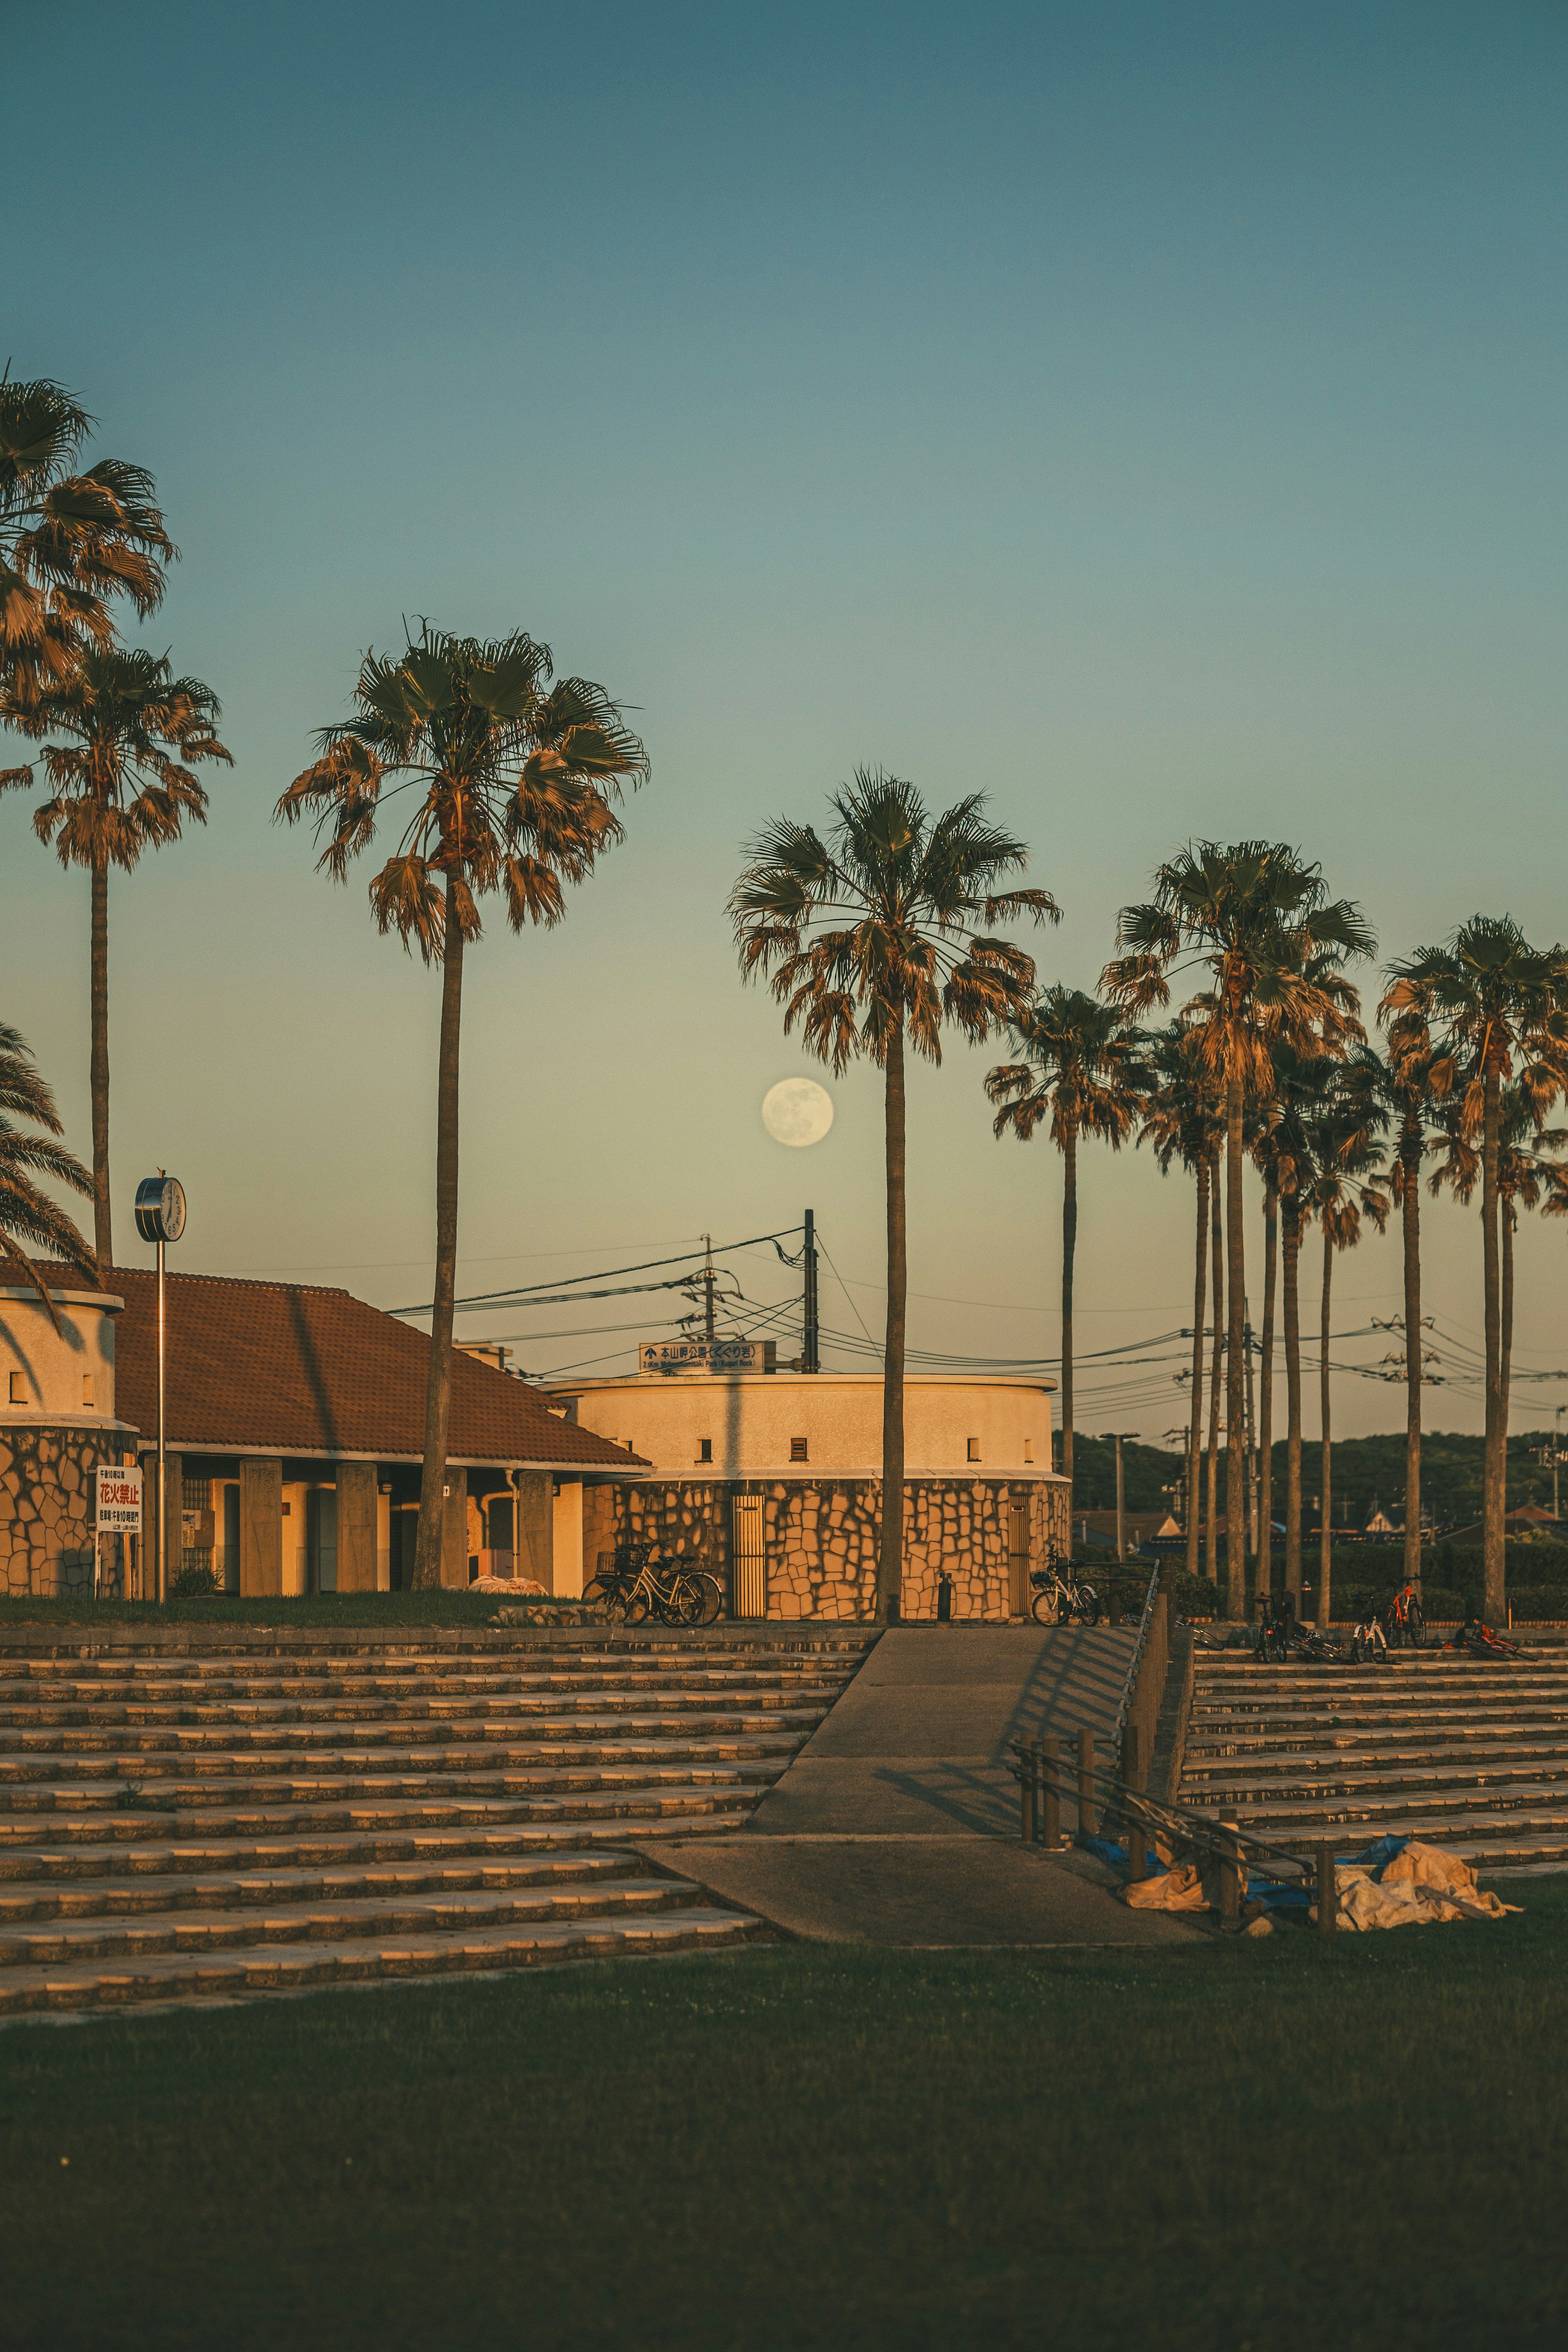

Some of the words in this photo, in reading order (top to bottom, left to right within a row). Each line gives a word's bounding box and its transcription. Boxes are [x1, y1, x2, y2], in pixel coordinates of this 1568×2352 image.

[176, 1195, 179, 1204] 2
[177, 1206, 180, 1215] 3
[176, 1216, 178, 1225] 4
[164, 1223, 167, 1232] 7
[168, 1226, 171, 1234] 6
[173, 1224, 175, 1232] 5
[100, 1470, 125, 1479] 午後10時以降
[100, 1483, 139, 1505] 花火禁止
